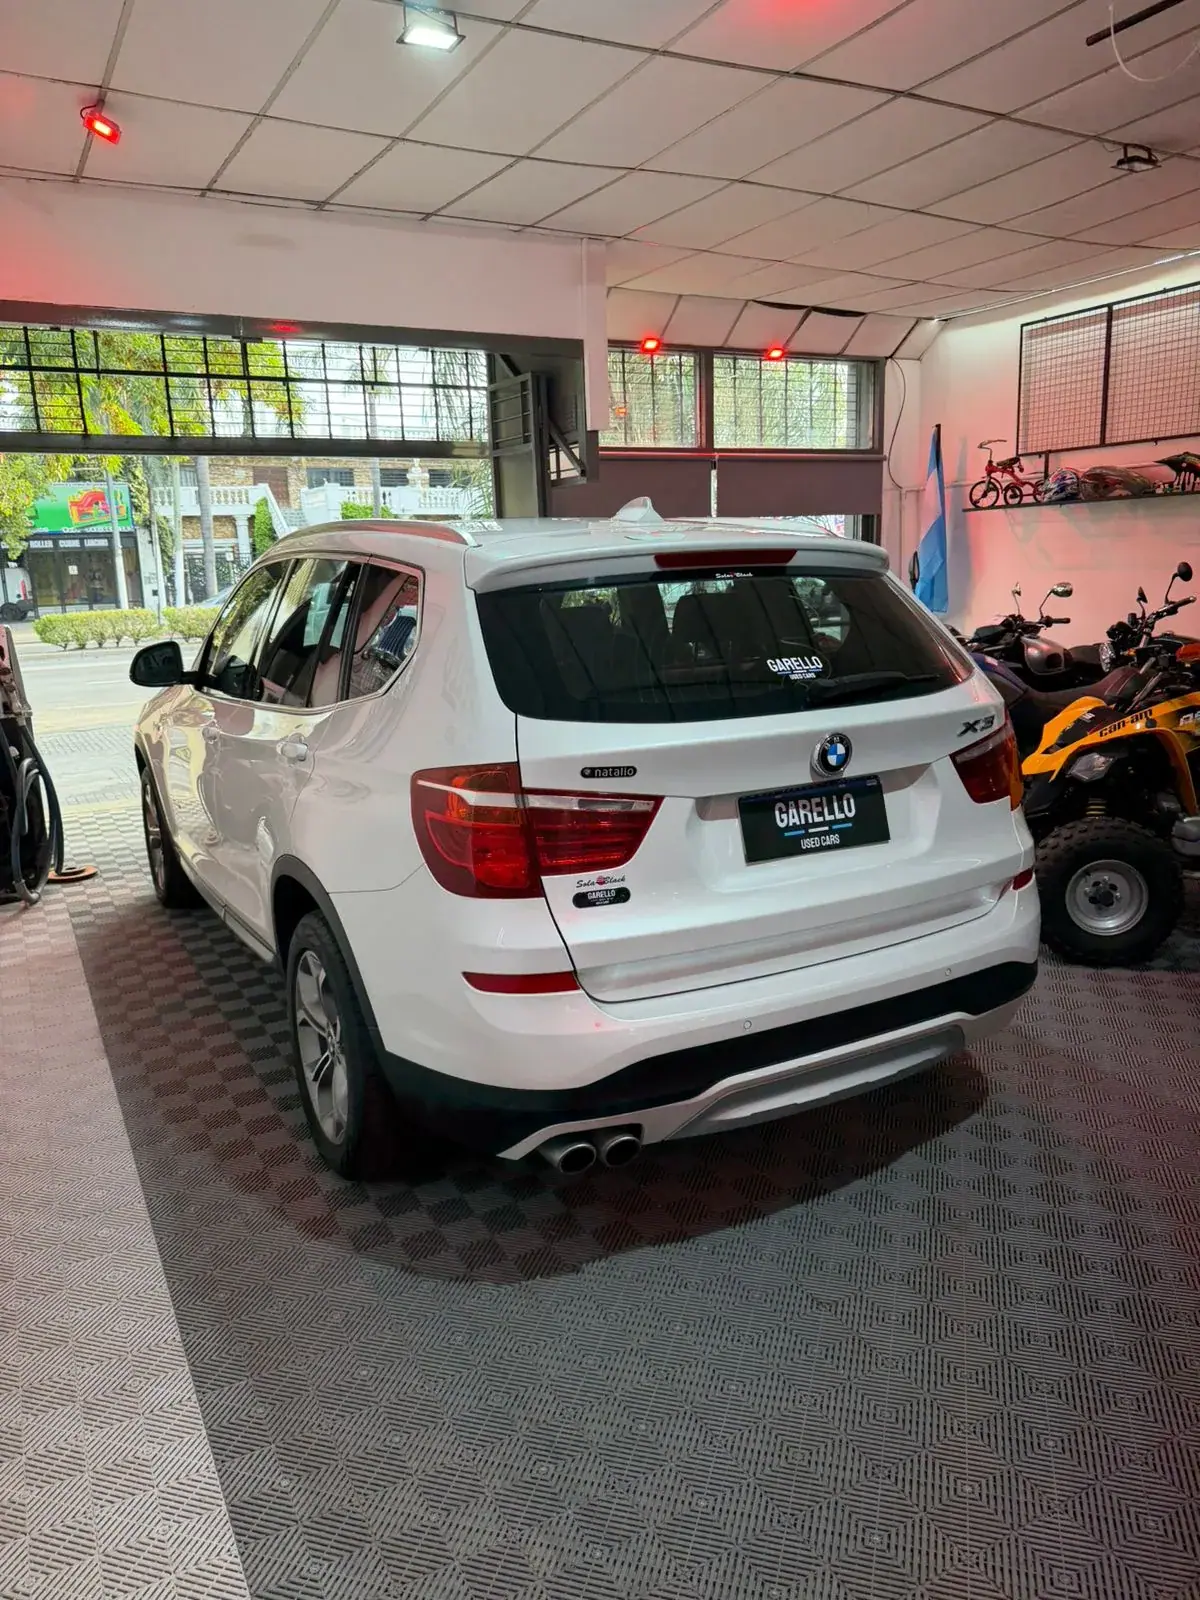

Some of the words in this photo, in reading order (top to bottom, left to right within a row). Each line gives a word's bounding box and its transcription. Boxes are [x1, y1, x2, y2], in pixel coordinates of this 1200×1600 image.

[766, 656, 823, 672] GARELLO
[957, 714, 995, 737] X3
[594, 767, 634, 777] natalio
[774, 793, 856, 828] GARELLO
[801, 837, 820, 850] USED
[821, 834, 840, 847] CARS
[576, 879, 596, 889] Sola
[603, 874, 626, 885] Black
[587, 889, 616, 900] GARELLO
